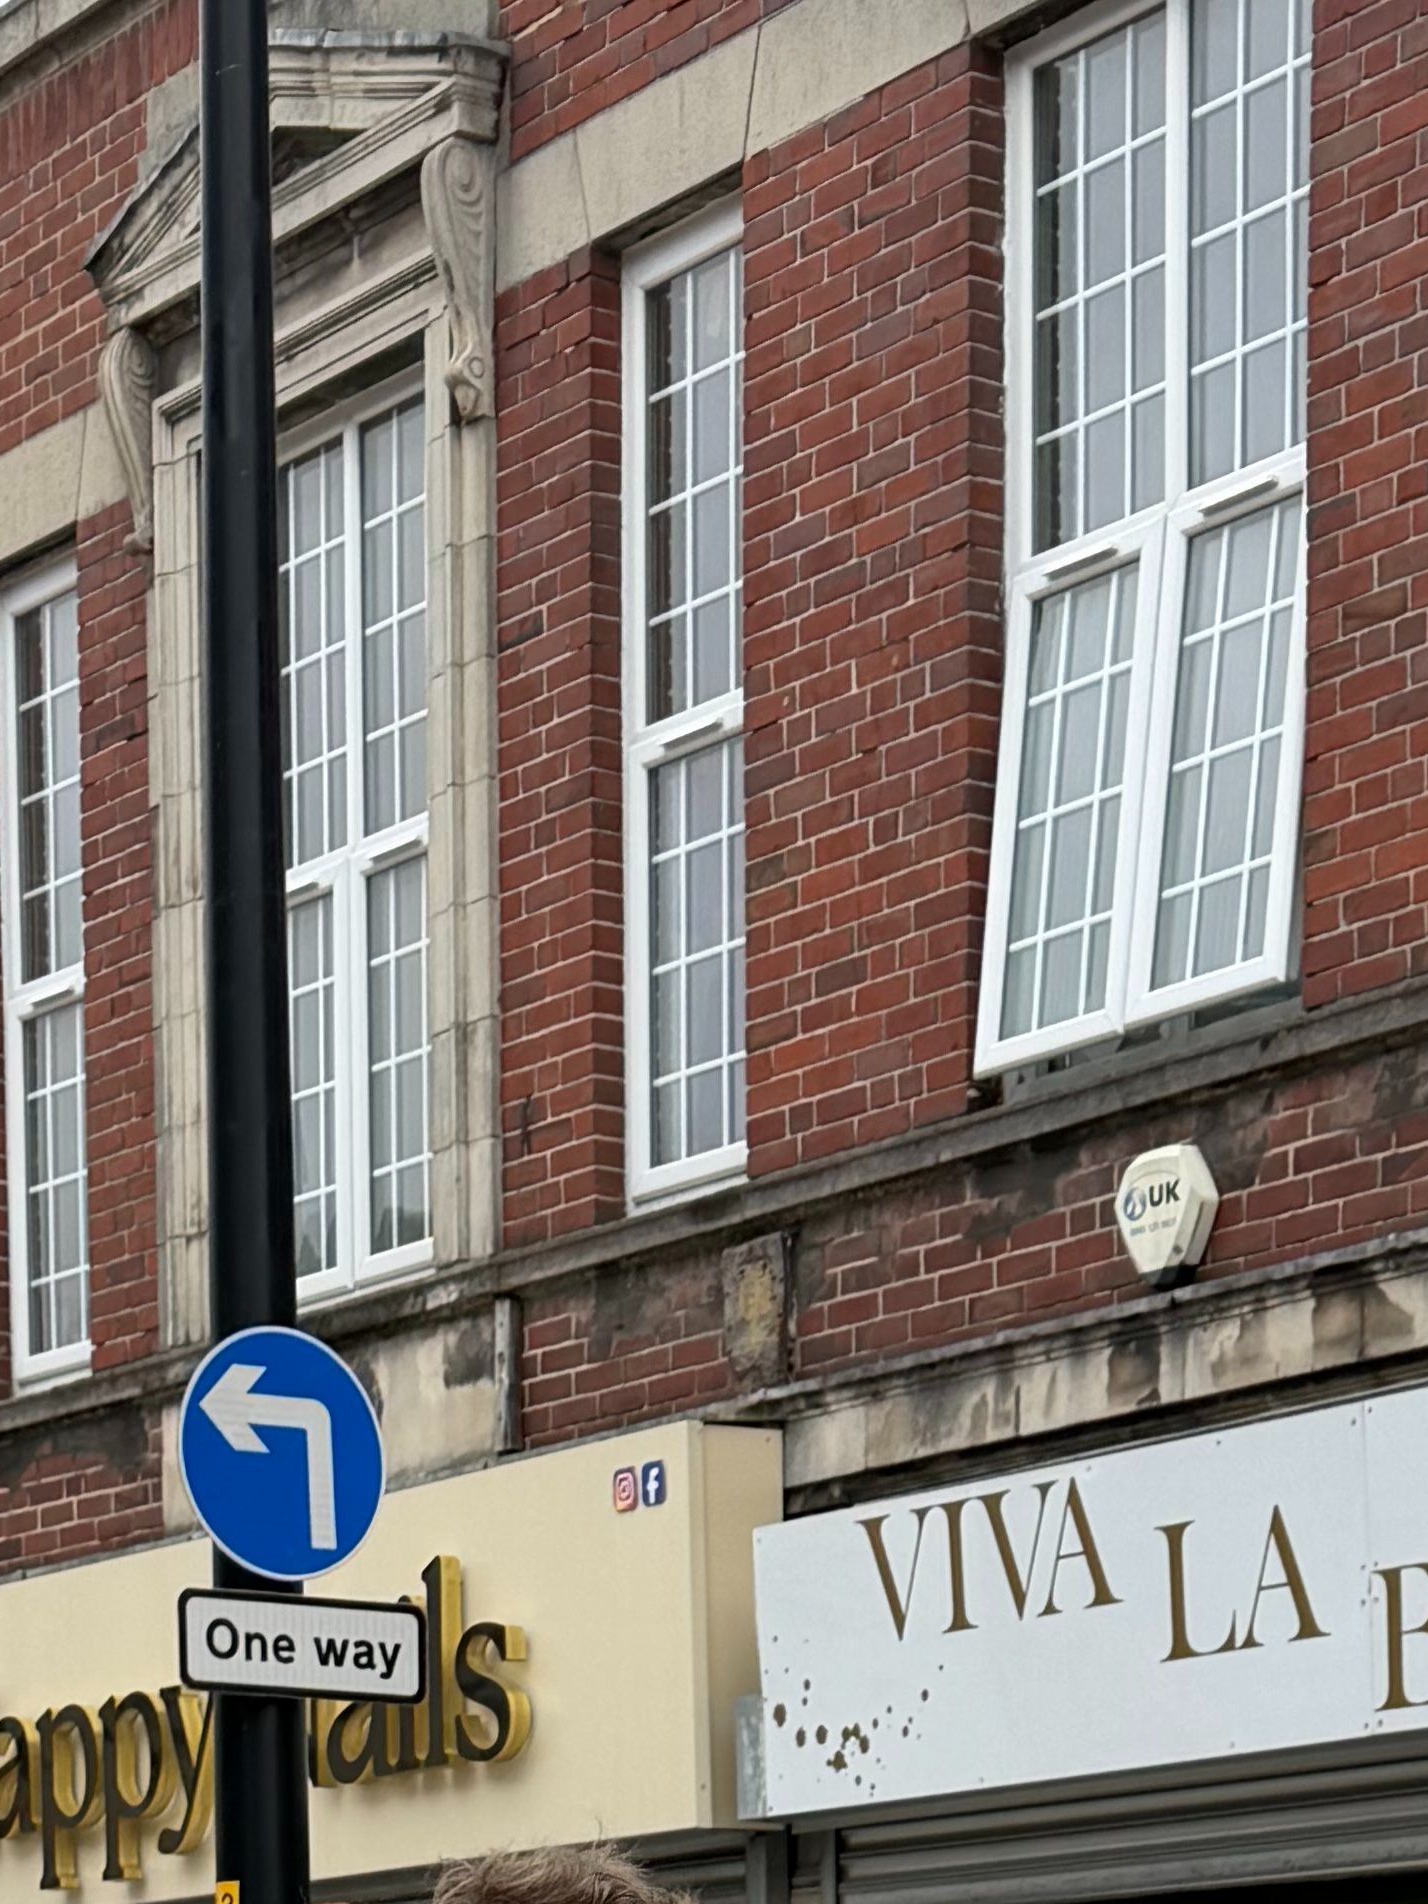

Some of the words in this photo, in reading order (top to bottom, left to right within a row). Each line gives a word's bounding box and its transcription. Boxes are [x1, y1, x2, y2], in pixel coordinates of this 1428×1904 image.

[1149, 1178, 1181, 1207] UK
[855, 1475, 1122, 1643] VIVA
[1154, 1503, 1330, 1663] LA
[206, 1618, 295, 1664] One
[314, 1637, 401, 1680] way
[309, 1554, 532, 1787] ails
